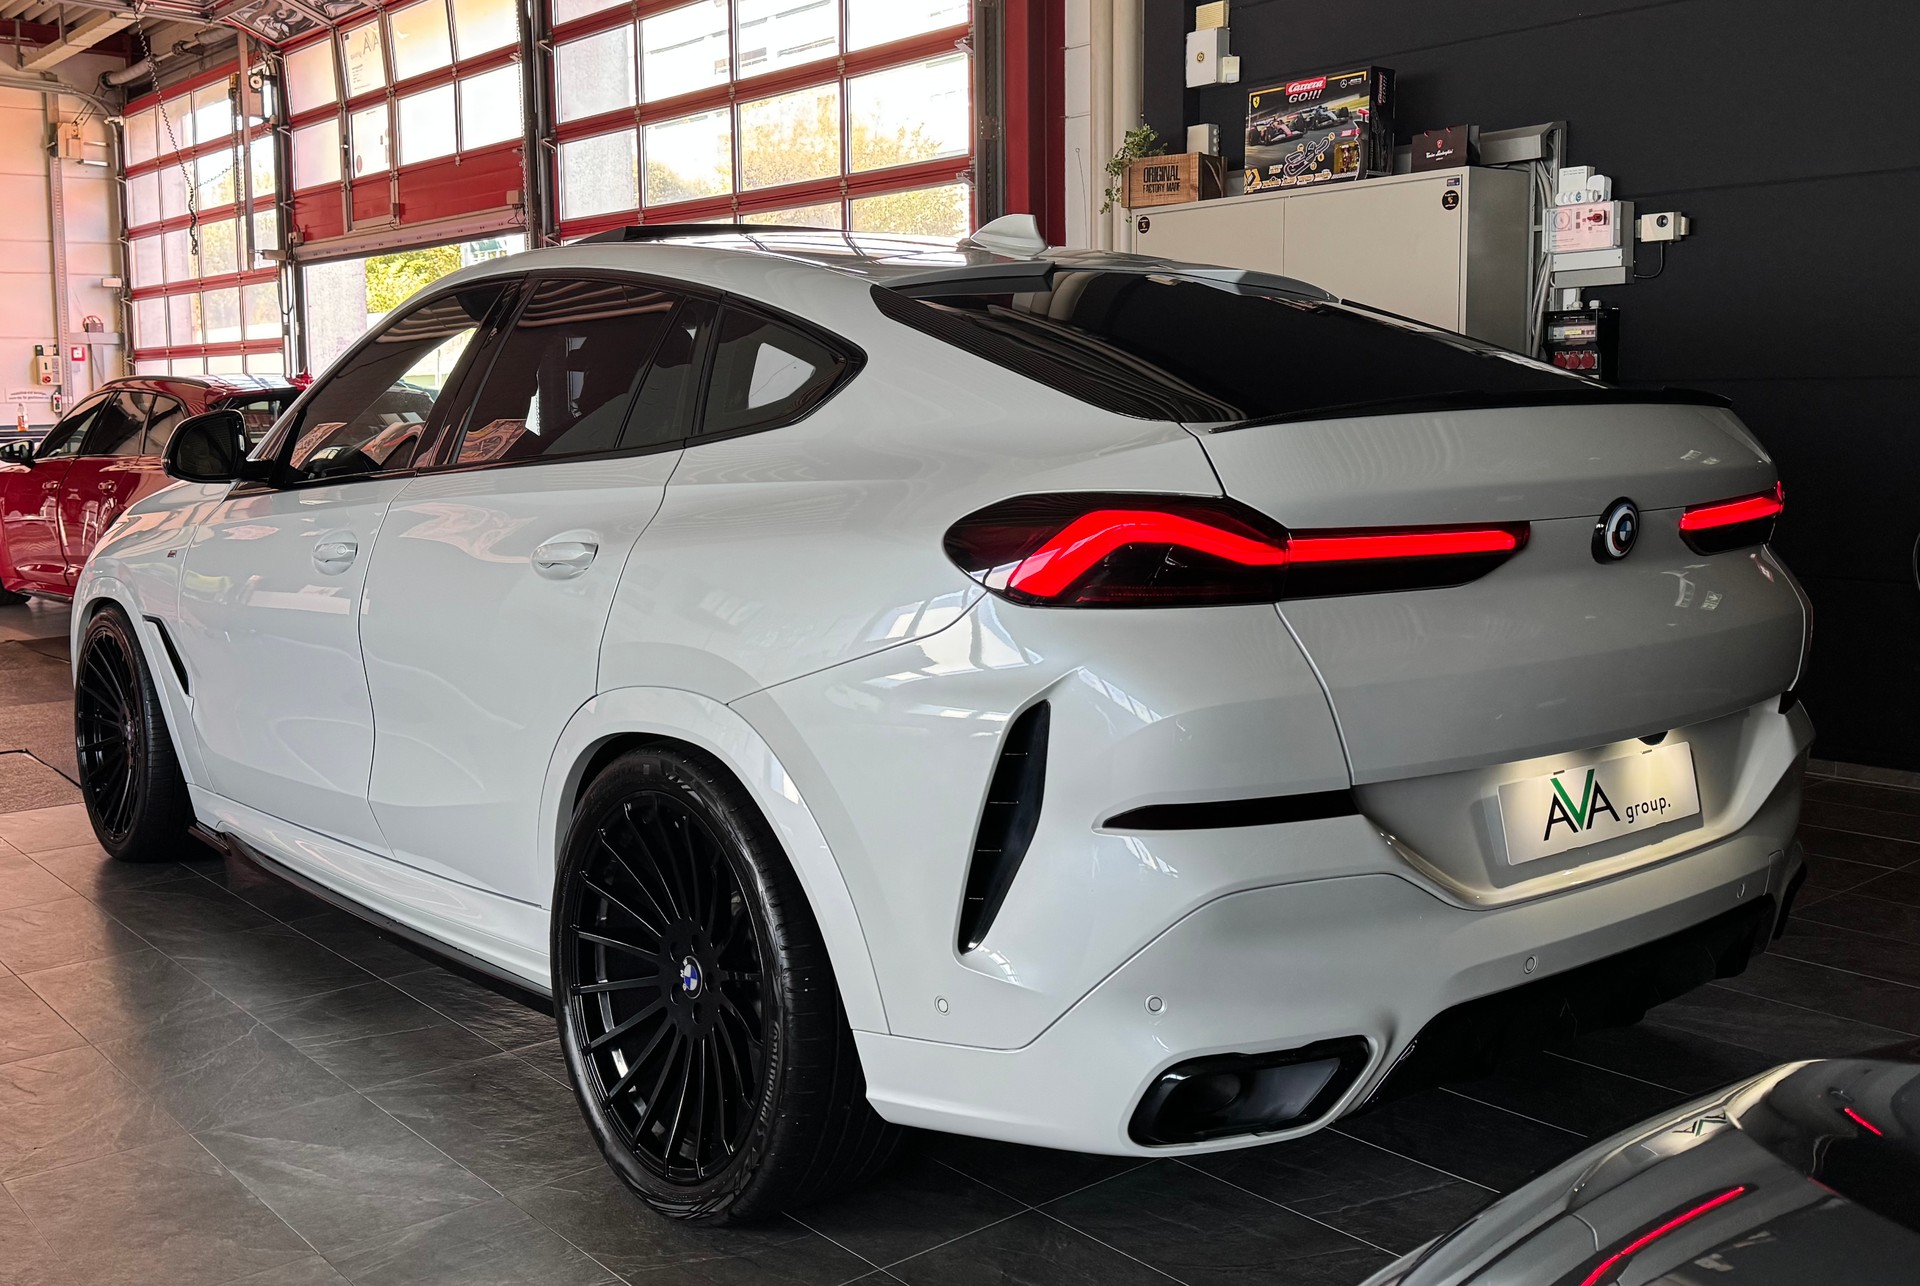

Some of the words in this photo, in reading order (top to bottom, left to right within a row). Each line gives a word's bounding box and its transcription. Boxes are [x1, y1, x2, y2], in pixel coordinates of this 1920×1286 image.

[1288, 80, 1324, 93] Carrera
[1288, 90, 1322, 104] GO!!!
[1143, 165, 1181, 183] ORIGINAL
[1143, 183, 1165, 194] FACTORY
[1166, 182, 1181, 192] MADE
[1543, 768, 1621, 841] AVA
[1625, 796, 1671, 824] group.
